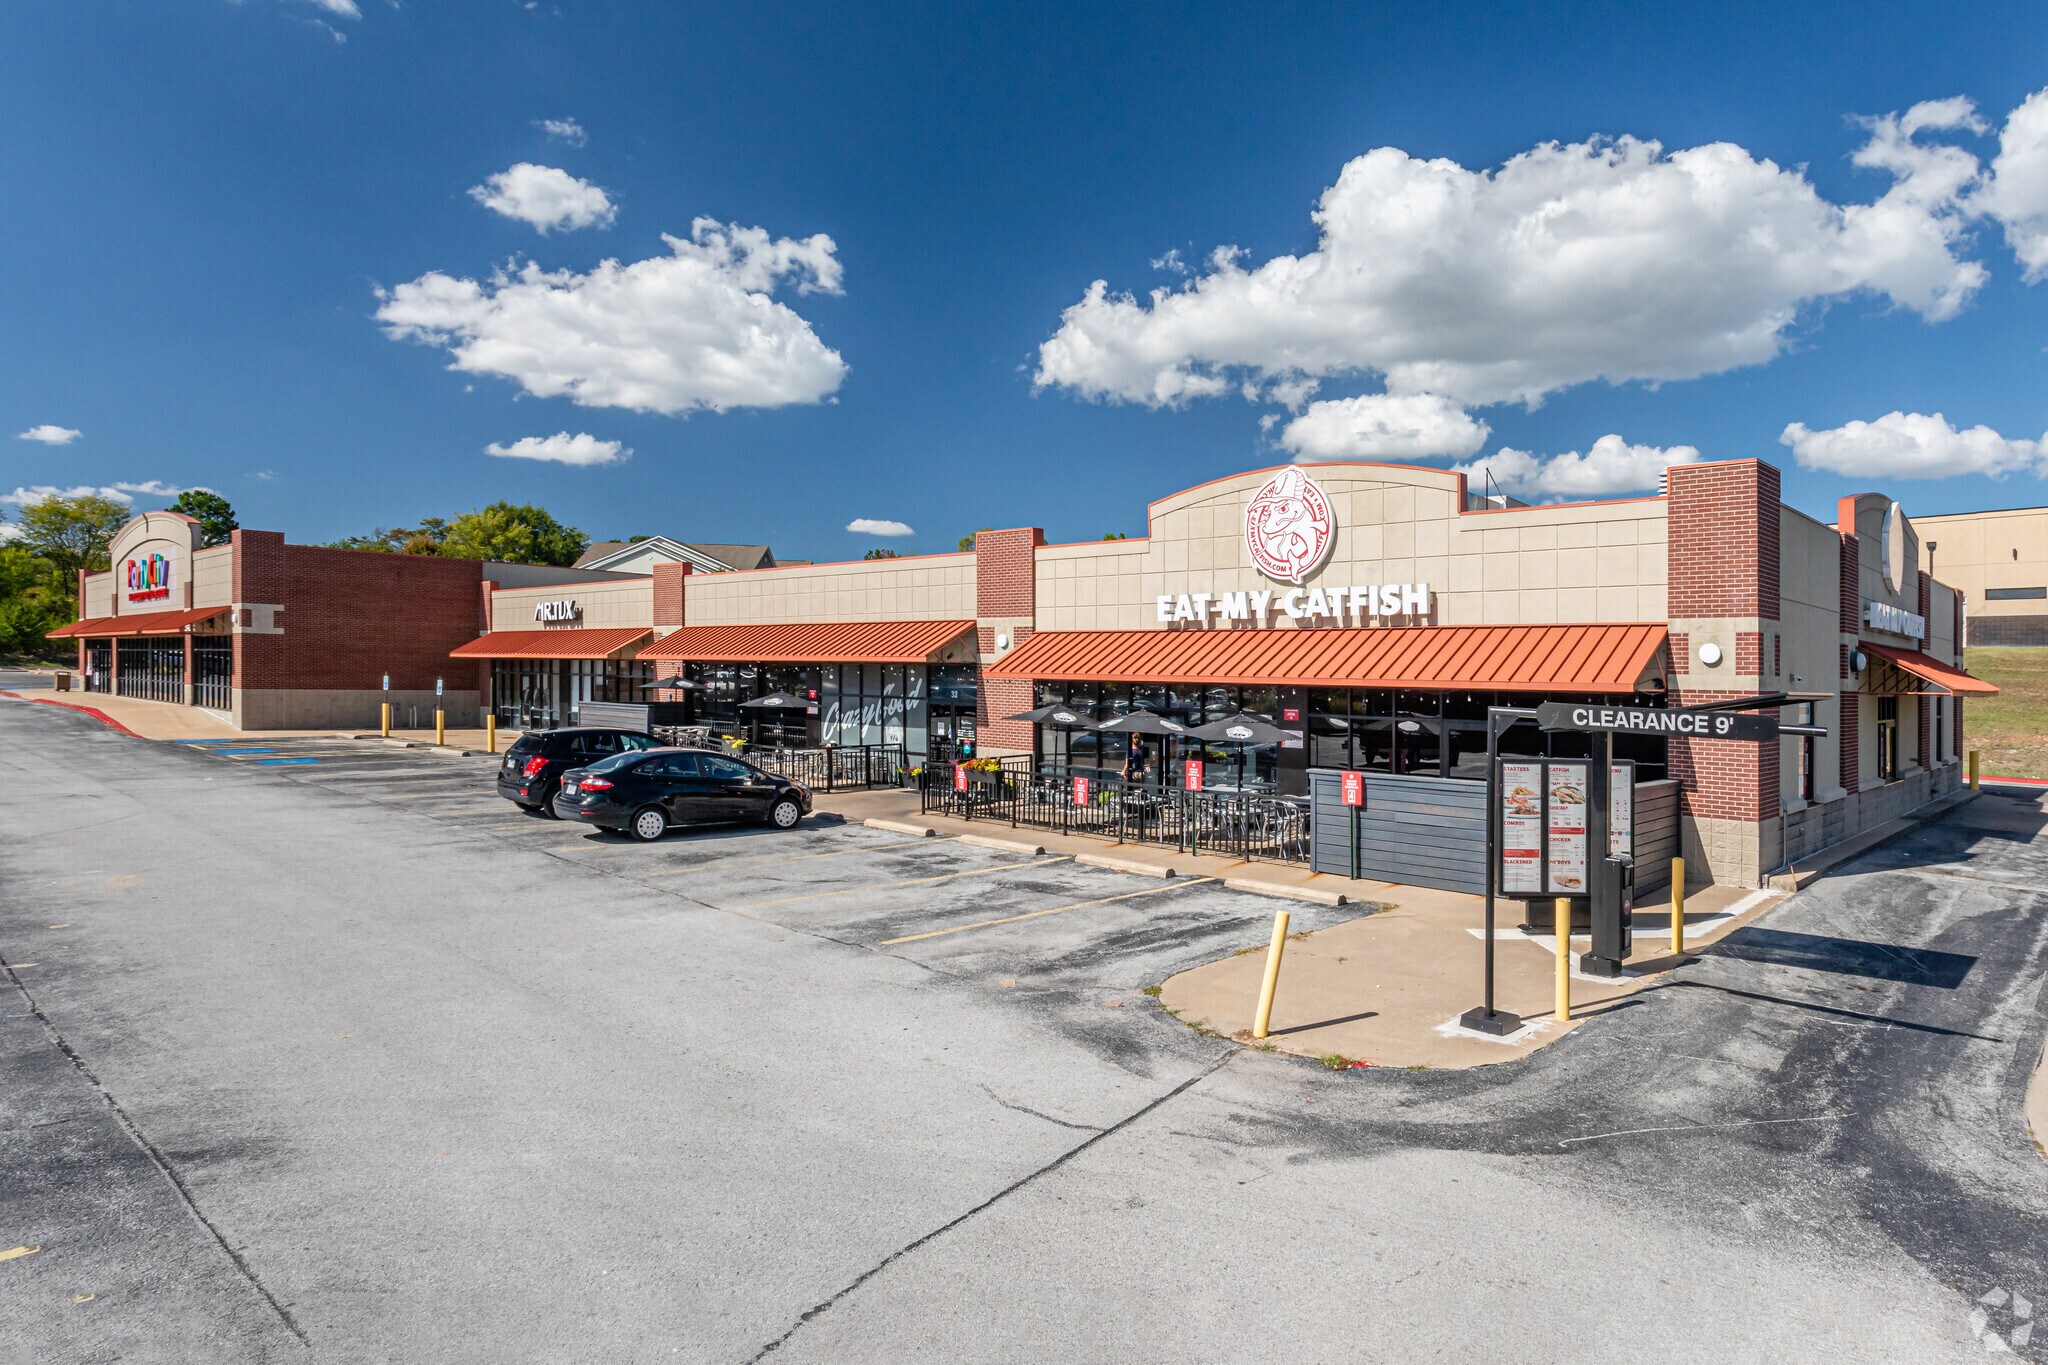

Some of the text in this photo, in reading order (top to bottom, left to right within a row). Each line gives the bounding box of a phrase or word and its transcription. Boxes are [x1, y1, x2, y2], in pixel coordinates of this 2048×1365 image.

[1250, 515, 1287, 572] ETMYCAFISH.COM
[1157, 583, 1430, 621] EAT MY CATFISH
[951, 690, 959, 699] 32
[823, 701, 876, 741] Crazy
[1572, 708, 1734, 735] CLEARANCE 9'
